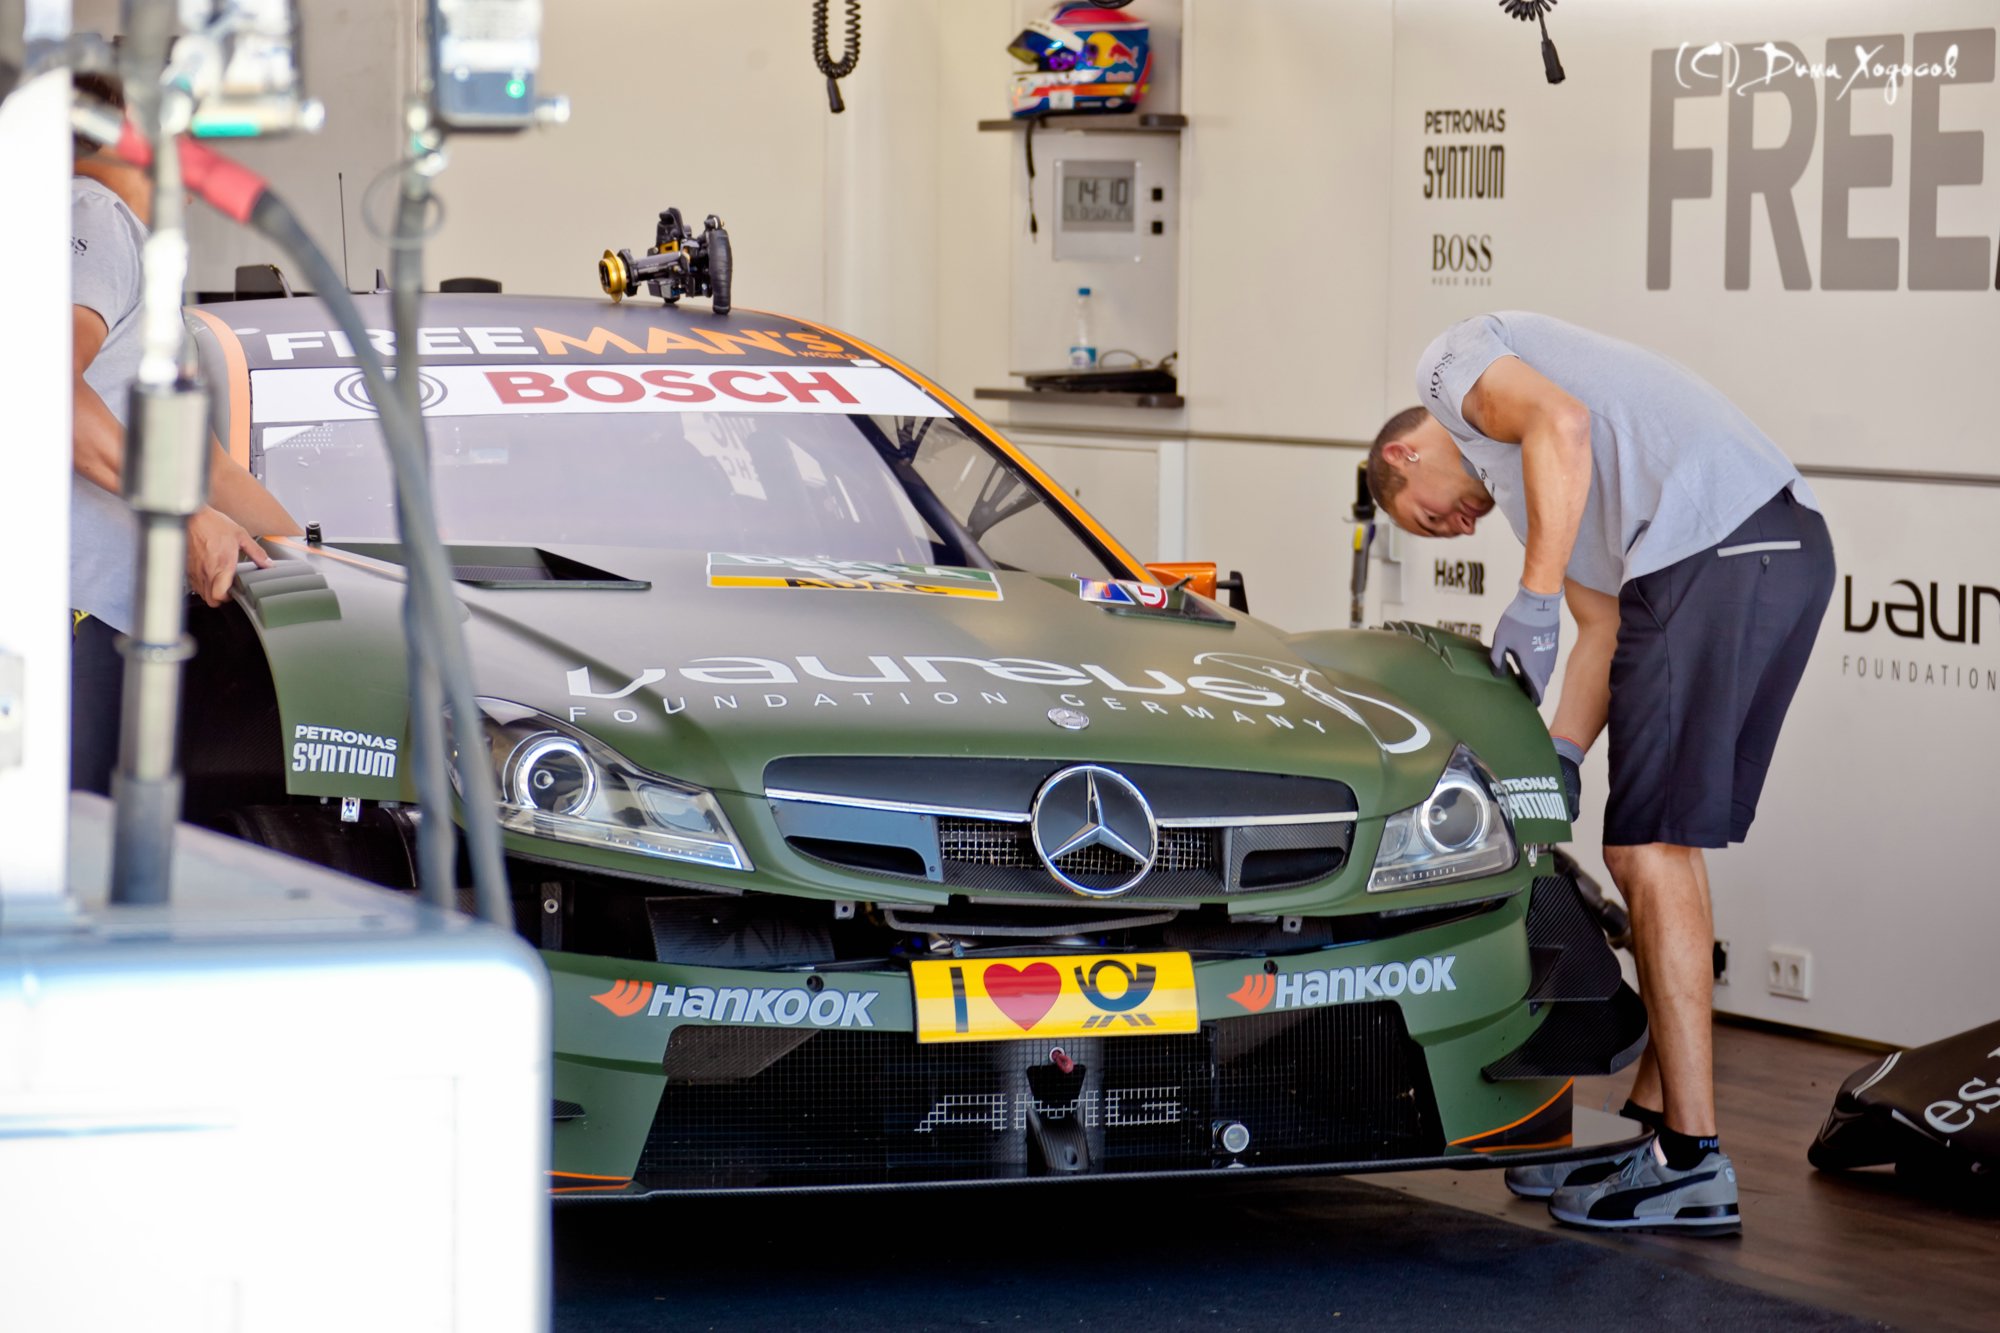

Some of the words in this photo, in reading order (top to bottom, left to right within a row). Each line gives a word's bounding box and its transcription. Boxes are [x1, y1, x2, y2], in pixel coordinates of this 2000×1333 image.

[1424, 107, 1506, 135] PETRONAS
[1423, 144, 1505, 200] SYNTIUM
[1645, 27, 2000, 292] FREE
[1431, 233, 1493, 273] BOSS
[482, 369, 862, 405] BOSCH
[1434, 558, 1466, 589] H&R
[1842, 654, 1998, 692] FOUNDATION
[569, 691, 1008, 724] FOUNDATION
[1059, 693, 1327, 735] GERMANY
[294, 724, 398, 751] PETRONAS
[291, 741, 397, 778] SYNTIUM
[949, 966, 970, 1034] I
[1923, 1046, 2000, 1134] es
